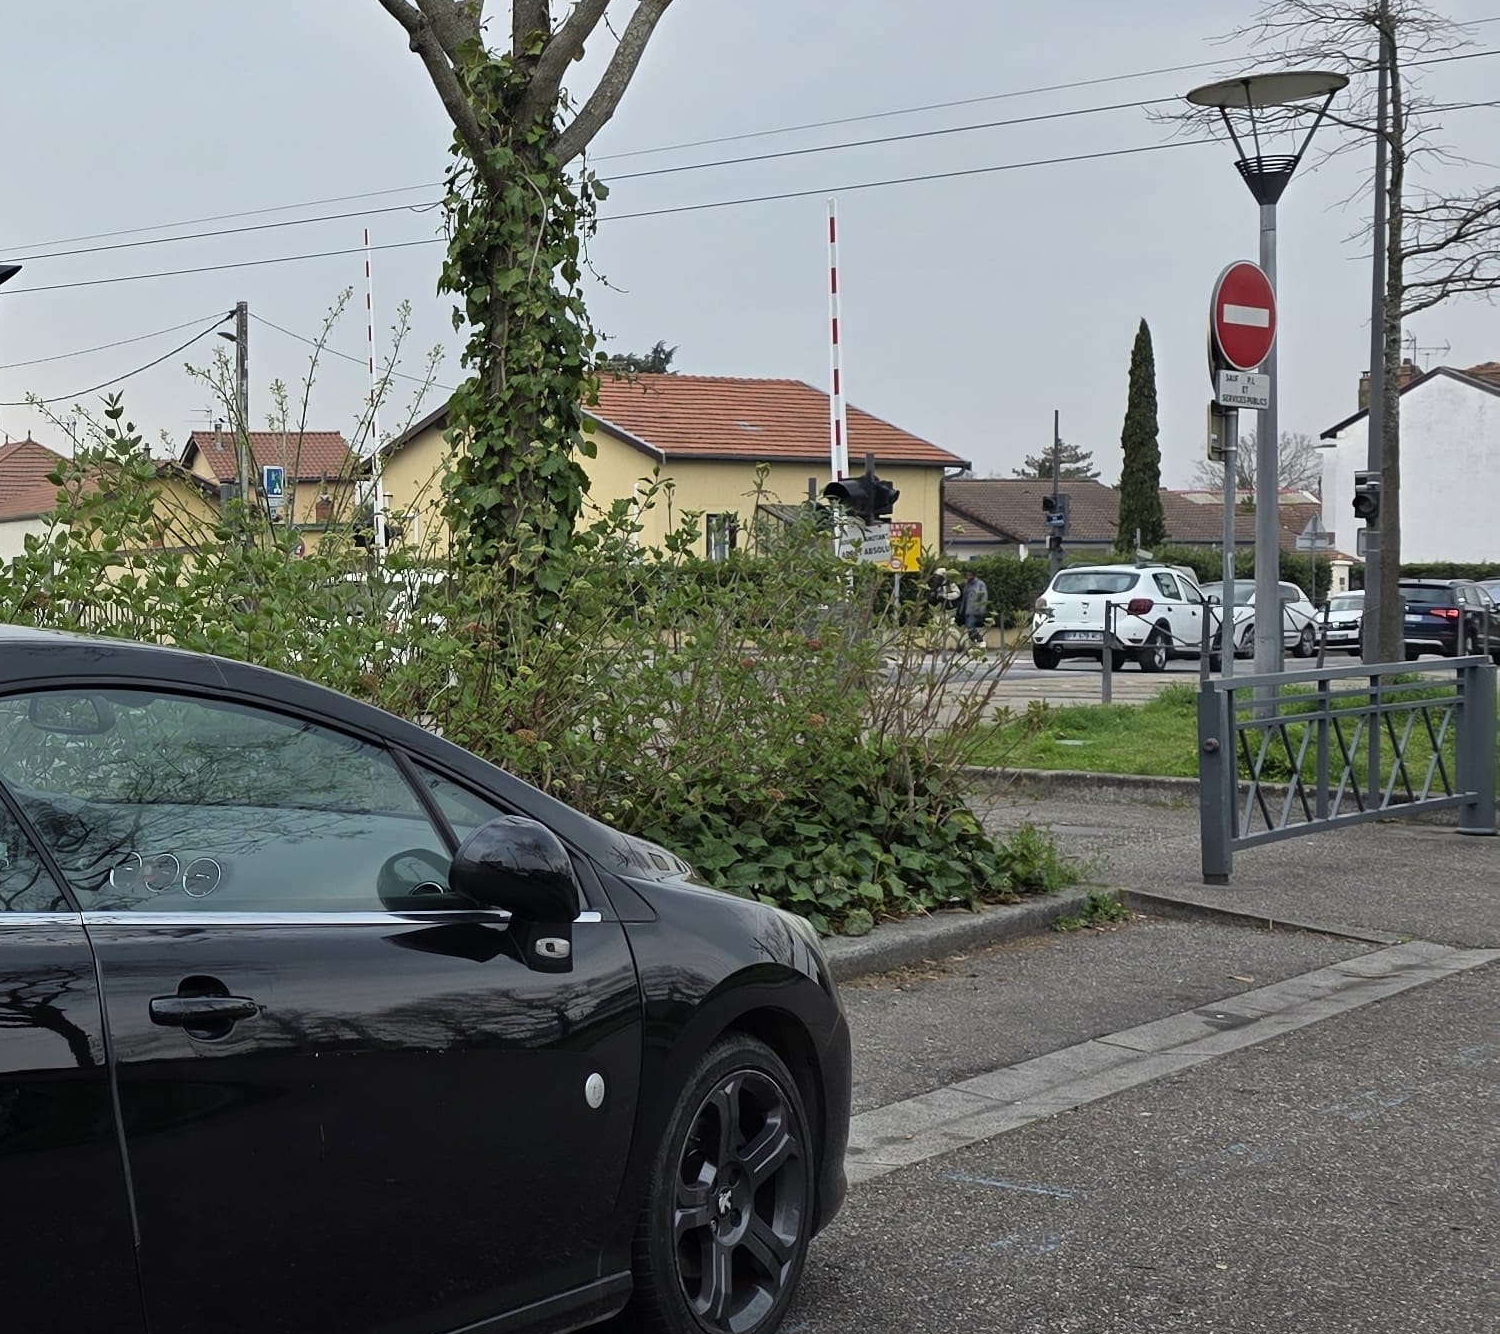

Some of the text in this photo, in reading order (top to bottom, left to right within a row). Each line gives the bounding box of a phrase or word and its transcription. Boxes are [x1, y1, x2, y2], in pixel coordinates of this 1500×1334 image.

[1242, 385, 1249, 394] ET
[1222, 394, 1267, 406] SERVICES PUBLICS
